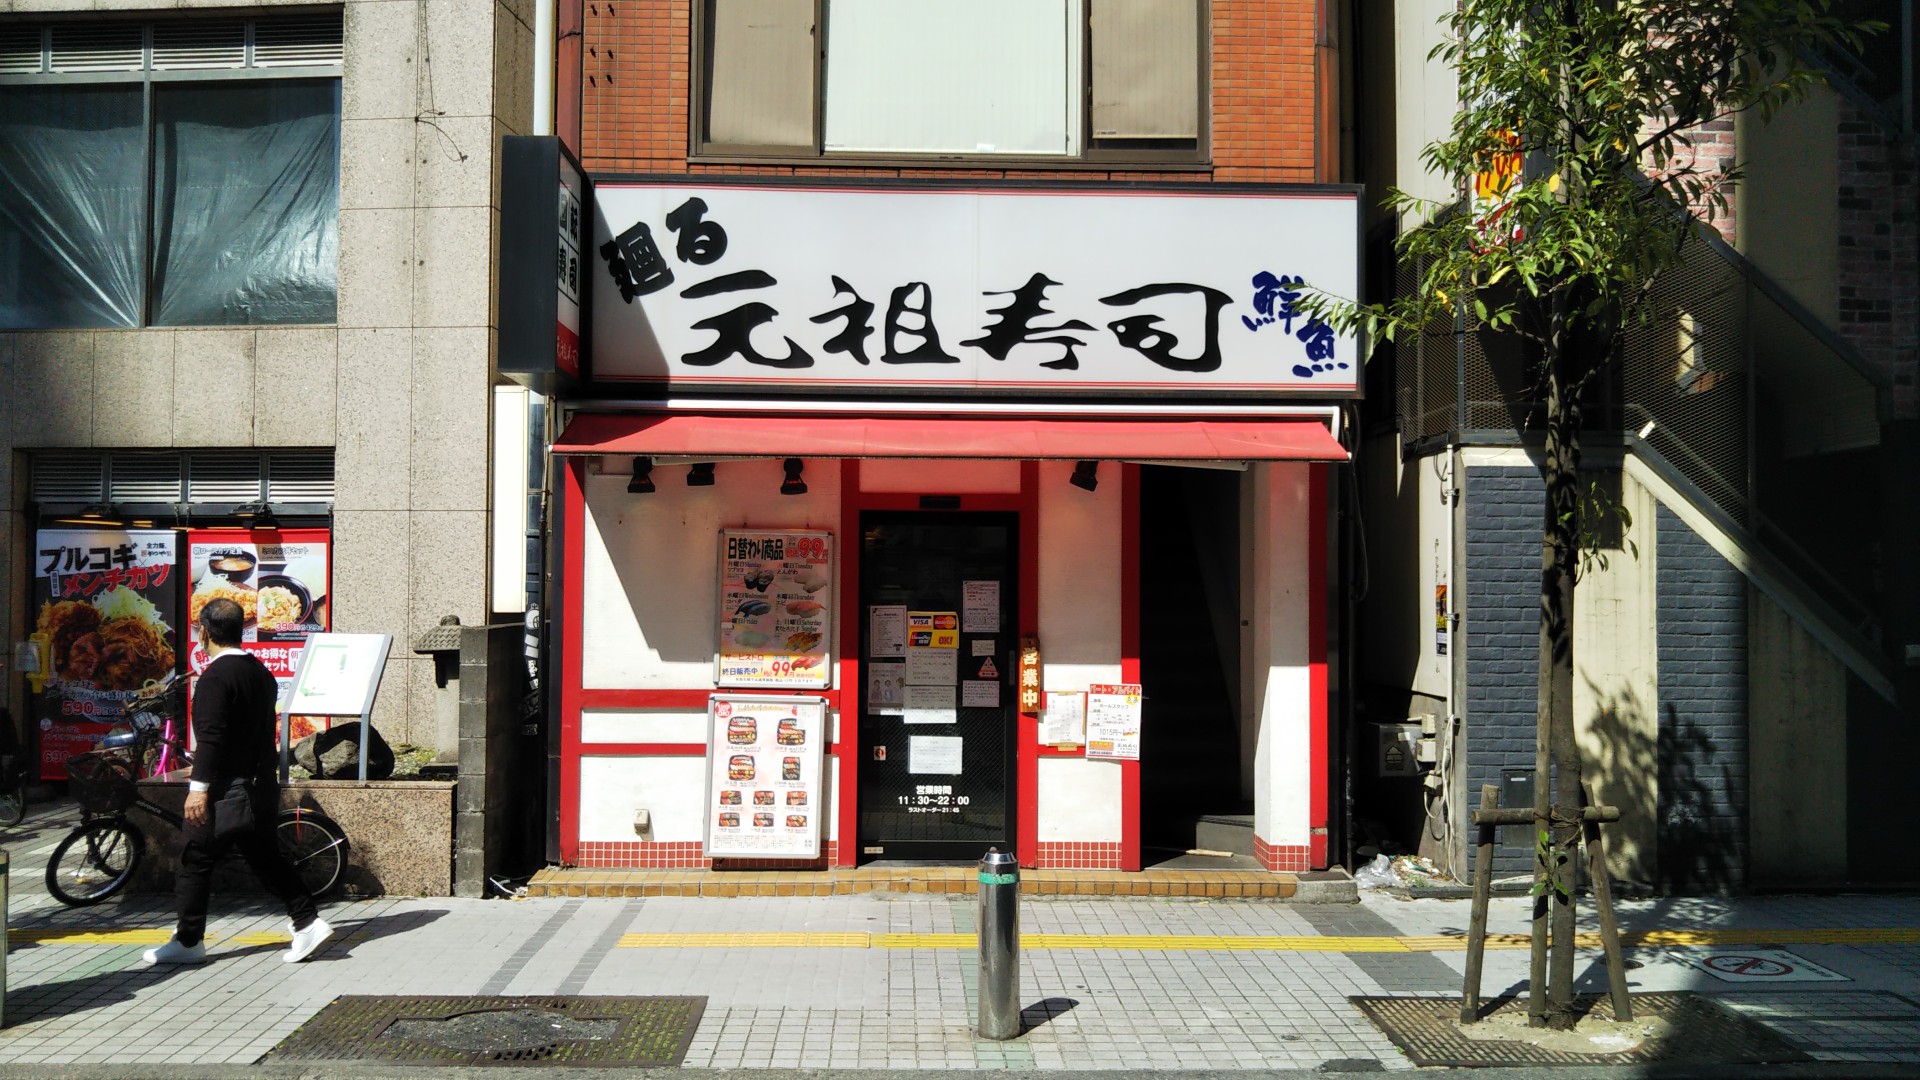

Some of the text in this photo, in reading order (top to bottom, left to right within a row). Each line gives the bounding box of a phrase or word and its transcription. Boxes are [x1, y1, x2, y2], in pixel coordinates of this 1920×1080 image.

[679, 272, 1235, 371] 元祖寿司
[40, 543, 138, 573] プルコギ
[727, 537, 784, 560] 日替わり商品
[62, 563, 170, 598] メンチカツ
[938, 636, 953, 645] OK!
[264, 660, 287, 672] セット
[1022, 646, 1038, 708] 営業中
[915, 785, 952, 795] 営業時間
